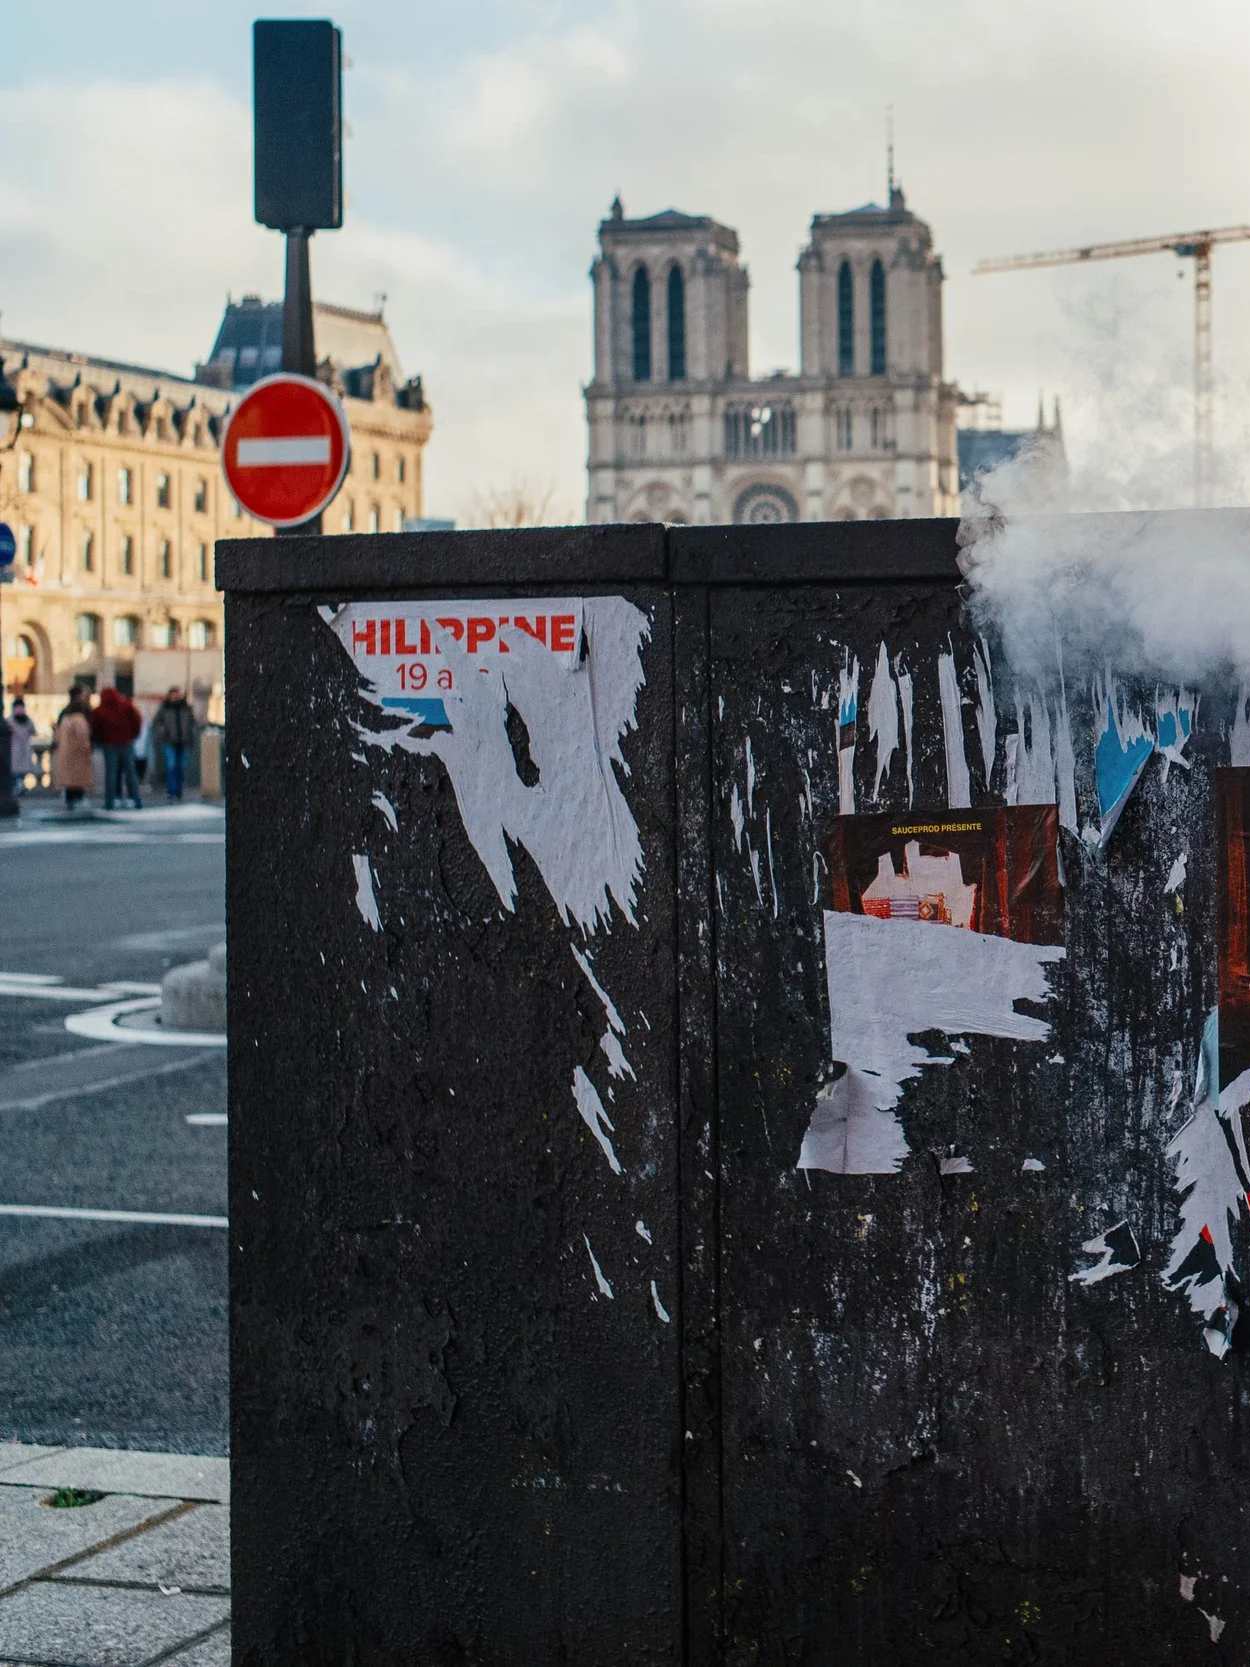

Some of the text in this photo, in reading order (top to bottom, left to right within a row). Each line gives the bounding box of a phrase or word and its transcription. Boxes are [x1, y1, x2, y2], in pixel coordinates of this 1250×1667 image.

[396, 662, 428, 691] 19
[891, 822, 982, 835] SAUCEPROD PRÉSENTE
